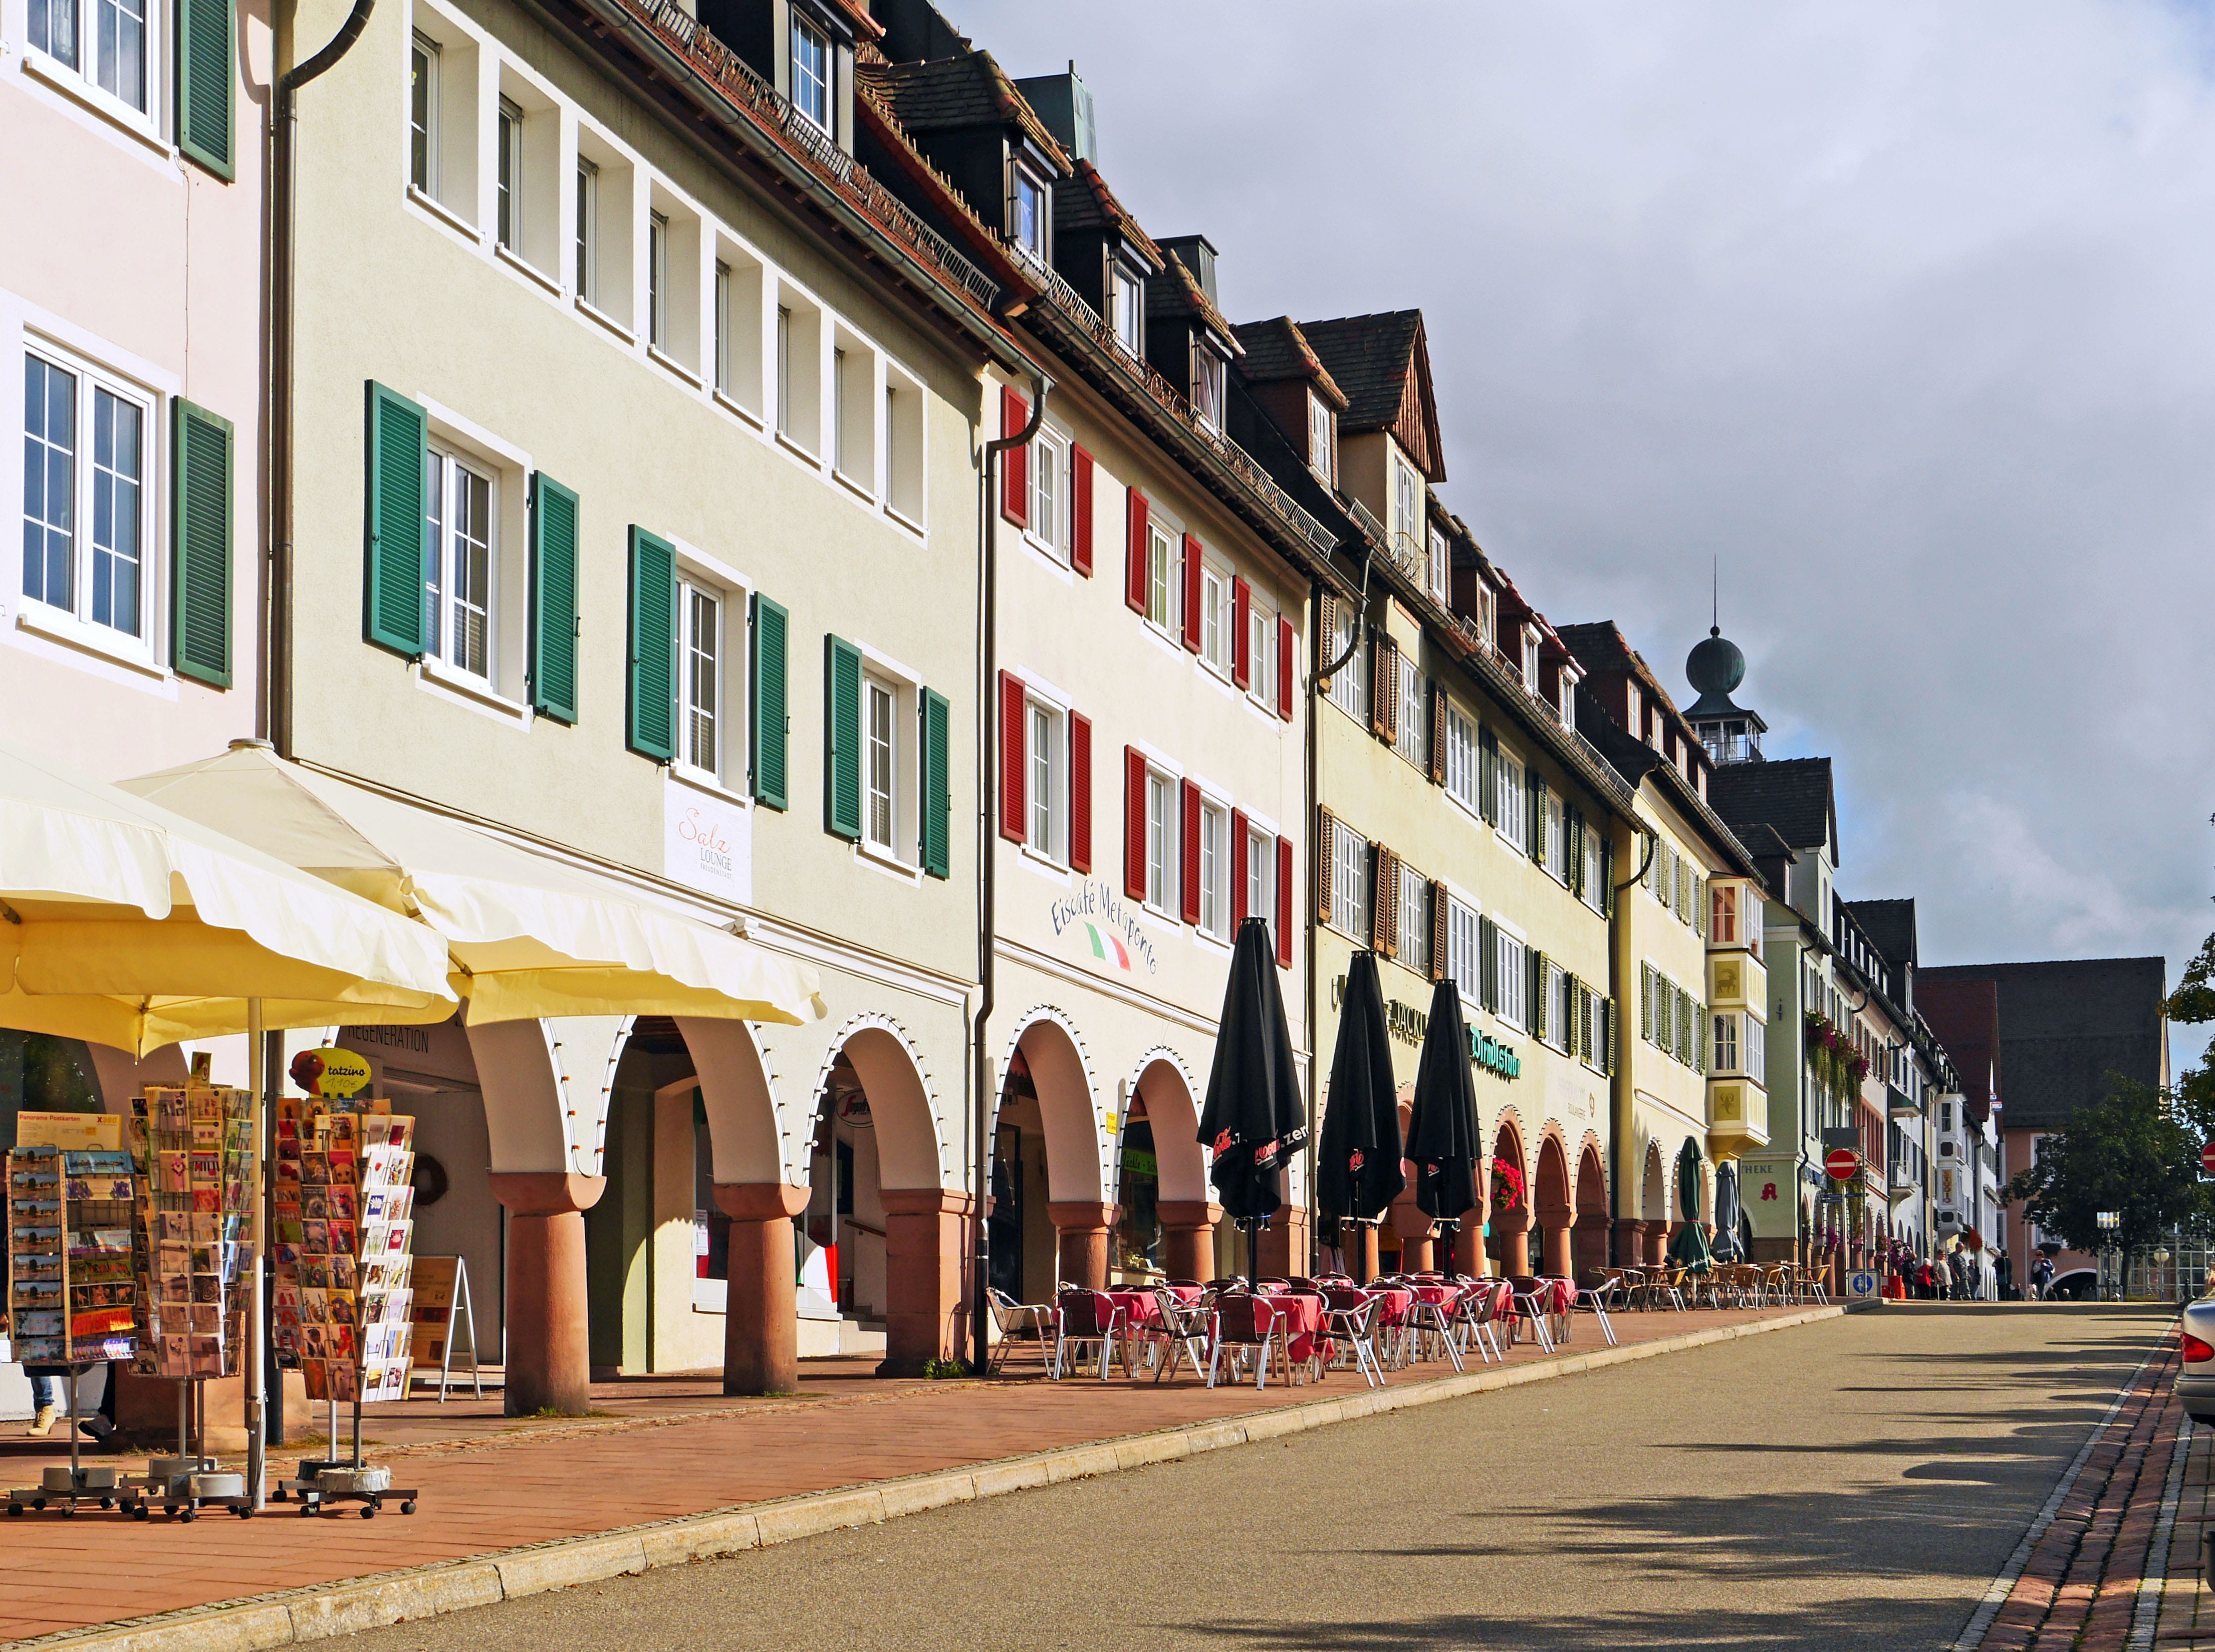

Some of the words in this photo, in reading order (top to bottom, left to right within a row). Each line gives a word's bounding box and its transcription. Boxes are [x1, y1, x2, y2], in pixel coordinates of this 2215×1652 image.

[679, 807, 731, 853] Salz
[700, 847, 732, 871] LOUNGE
[1051, 879, 1095, 936] Eiscafé
[1099, 883, 1157, 975] Metaponto
[328, 1065, 365, 1076] tatzino
[1943, 1169, 1951, 1203] STUDIO
